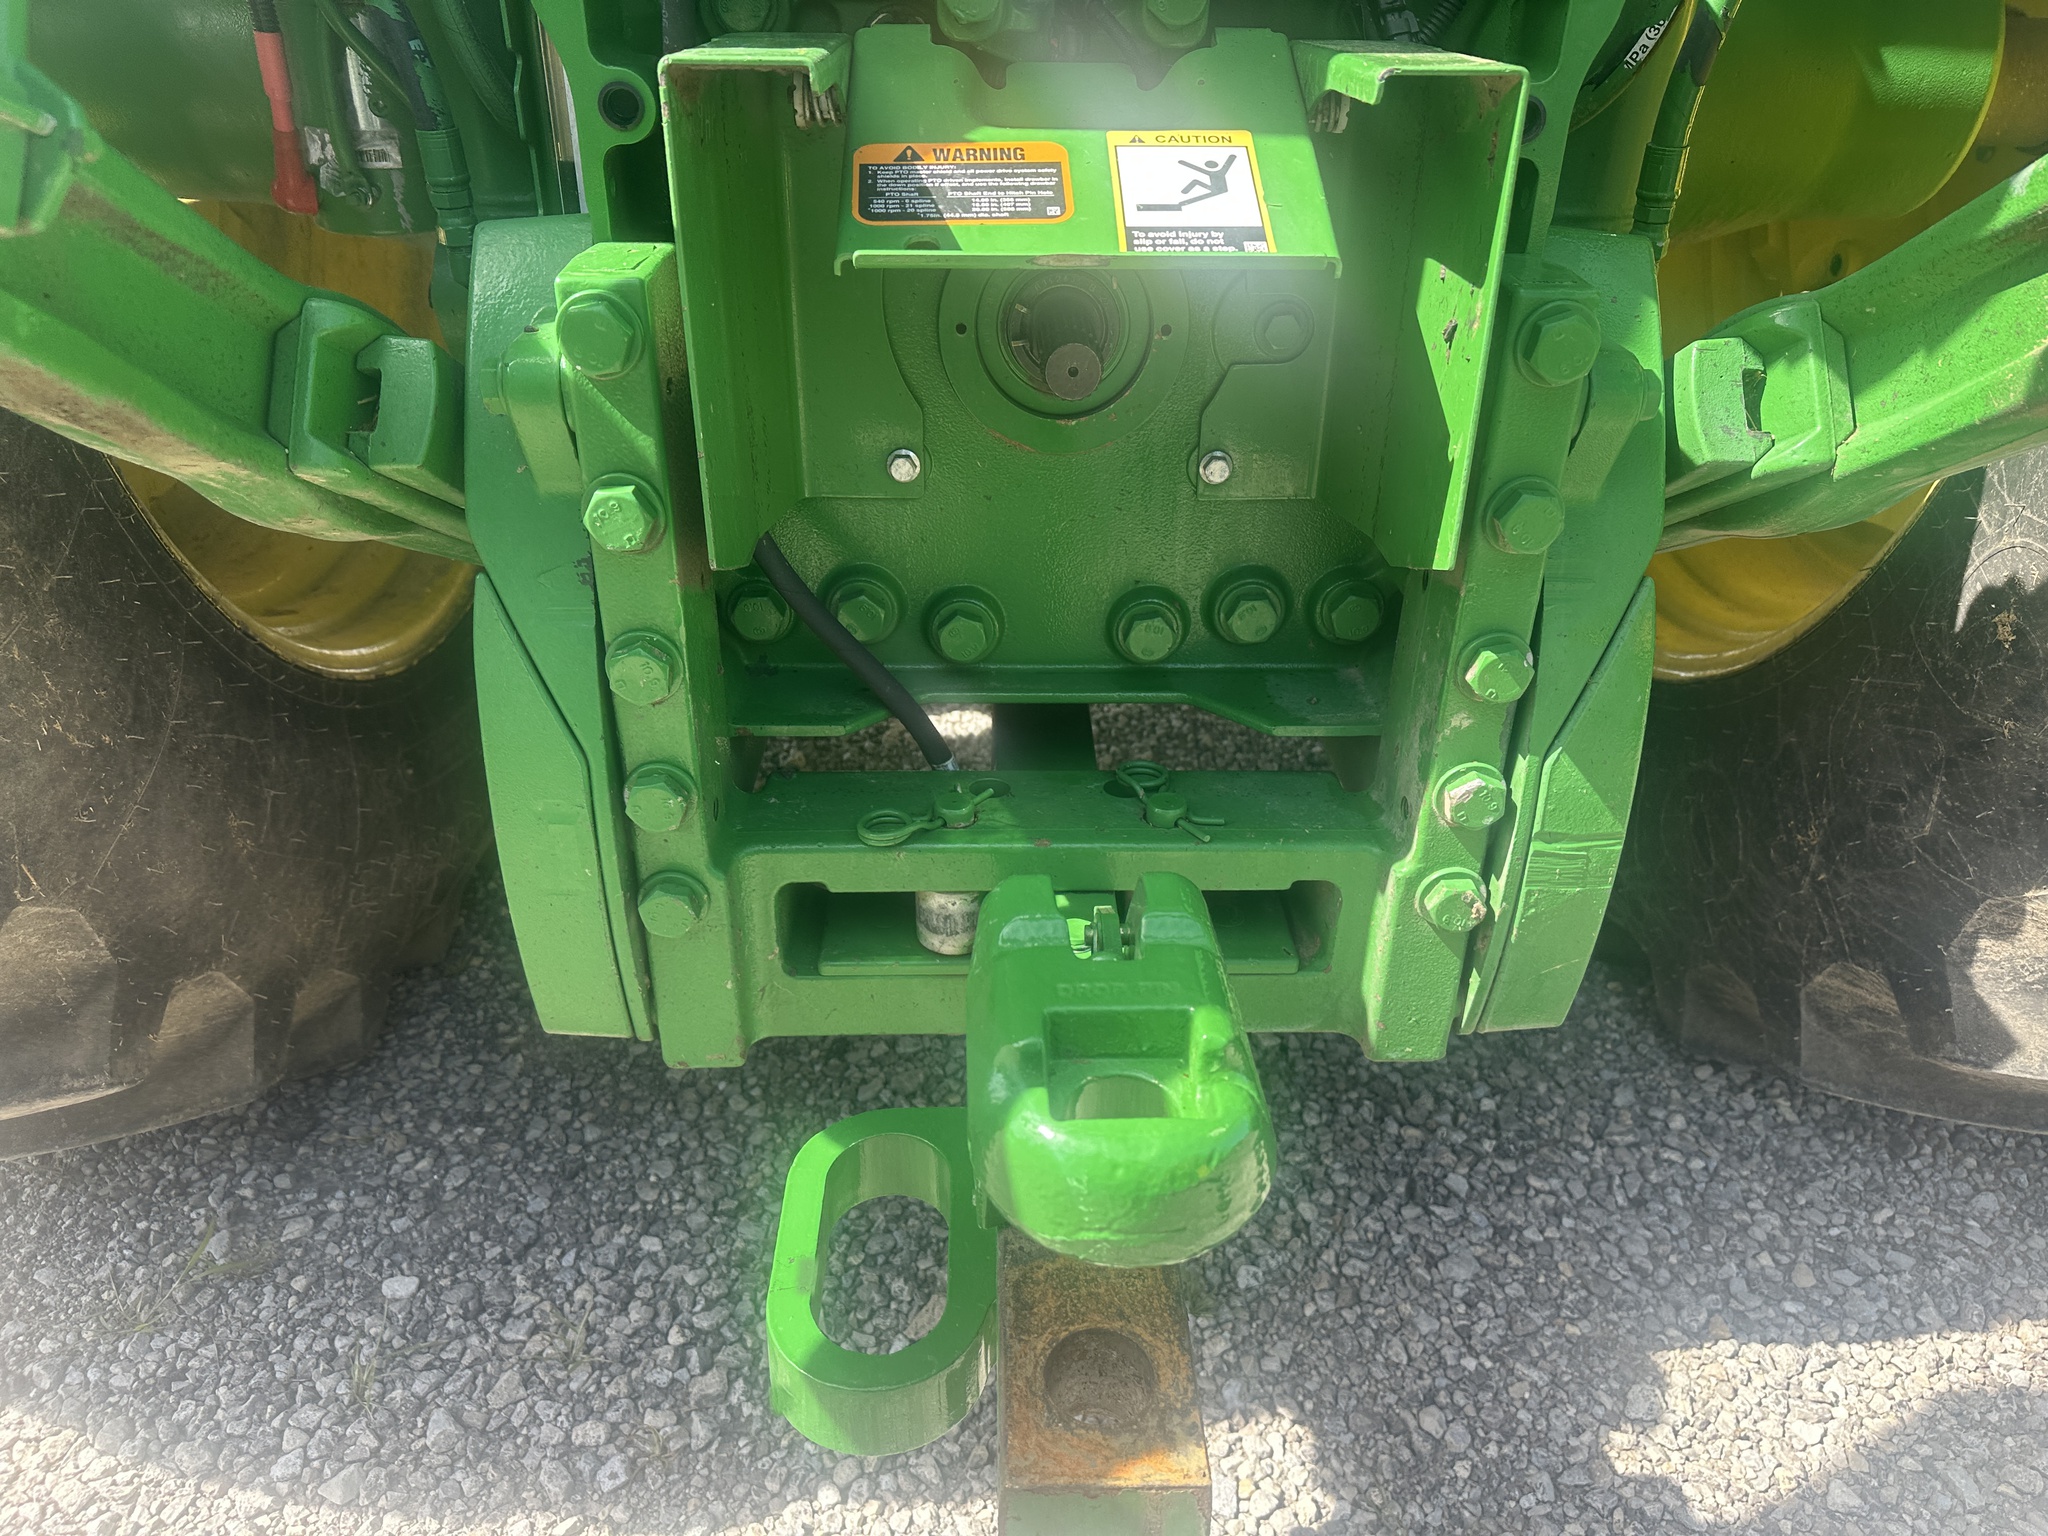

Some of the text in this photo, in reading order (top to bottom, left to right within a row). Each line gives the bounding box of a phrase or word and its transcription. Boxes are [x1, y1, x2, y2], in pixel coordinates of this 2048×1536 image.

[1155, 135, 1233, 143] CAUTION
[932, 147, 1026, 162] WARNING
[1148, 230, 1176, 238] avoid
[1178, 230, 1209, 239] injury
[1211, 230, 1224, 238] by
[1133, 238, 1153, 246] slip
[1168, 238, 1189, 246] fall,
